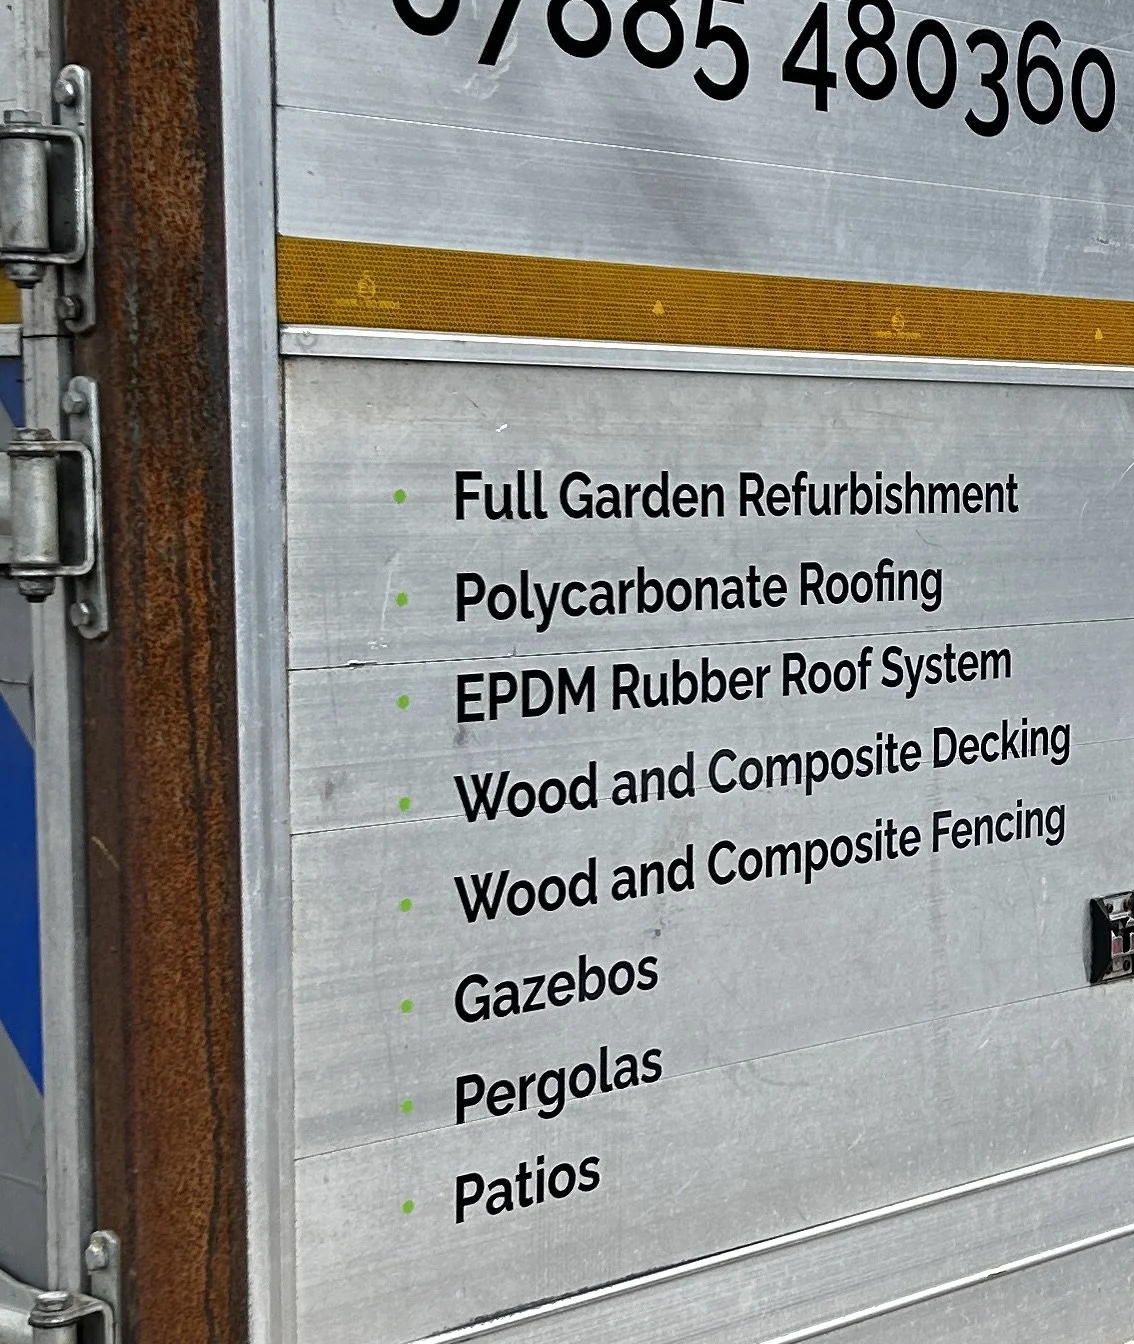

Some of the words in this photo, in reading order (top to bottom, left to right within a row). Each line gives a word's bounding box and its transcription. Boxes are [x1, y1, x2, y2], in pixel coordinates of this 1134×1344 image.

[455, 469, 548, 521] Full
[559, 470, 725, 519] Garden
[739, 470, 1019, 517] Refurbishment
[456, 565, 788, 633] Polycarbonate
[800, 557, 943, 613] Roofing
[457, 665, 596, 724] EPDM
[612, 657, 771, 711] Rubber
[782, 645, 874, 697] Roof
[881, 643, 1011, 700] System
[453, 760, 598, 823] Wood
[611, 750, 695, 806] and
[708, 733, 922, 796] Composite
[933, 719, 1071, 769] Decking
[453, 856, 598, 924] Wood
[611, 846, 695, 901] and
[707, 818, 922, 886] Composite
[932, 799, 1065, 853] Fencing
[454, 954, 658, 1023] Gazebos
[454, 1045, 662, 1126] Pergolas
[455, 1154, 600, 1224] Patios
